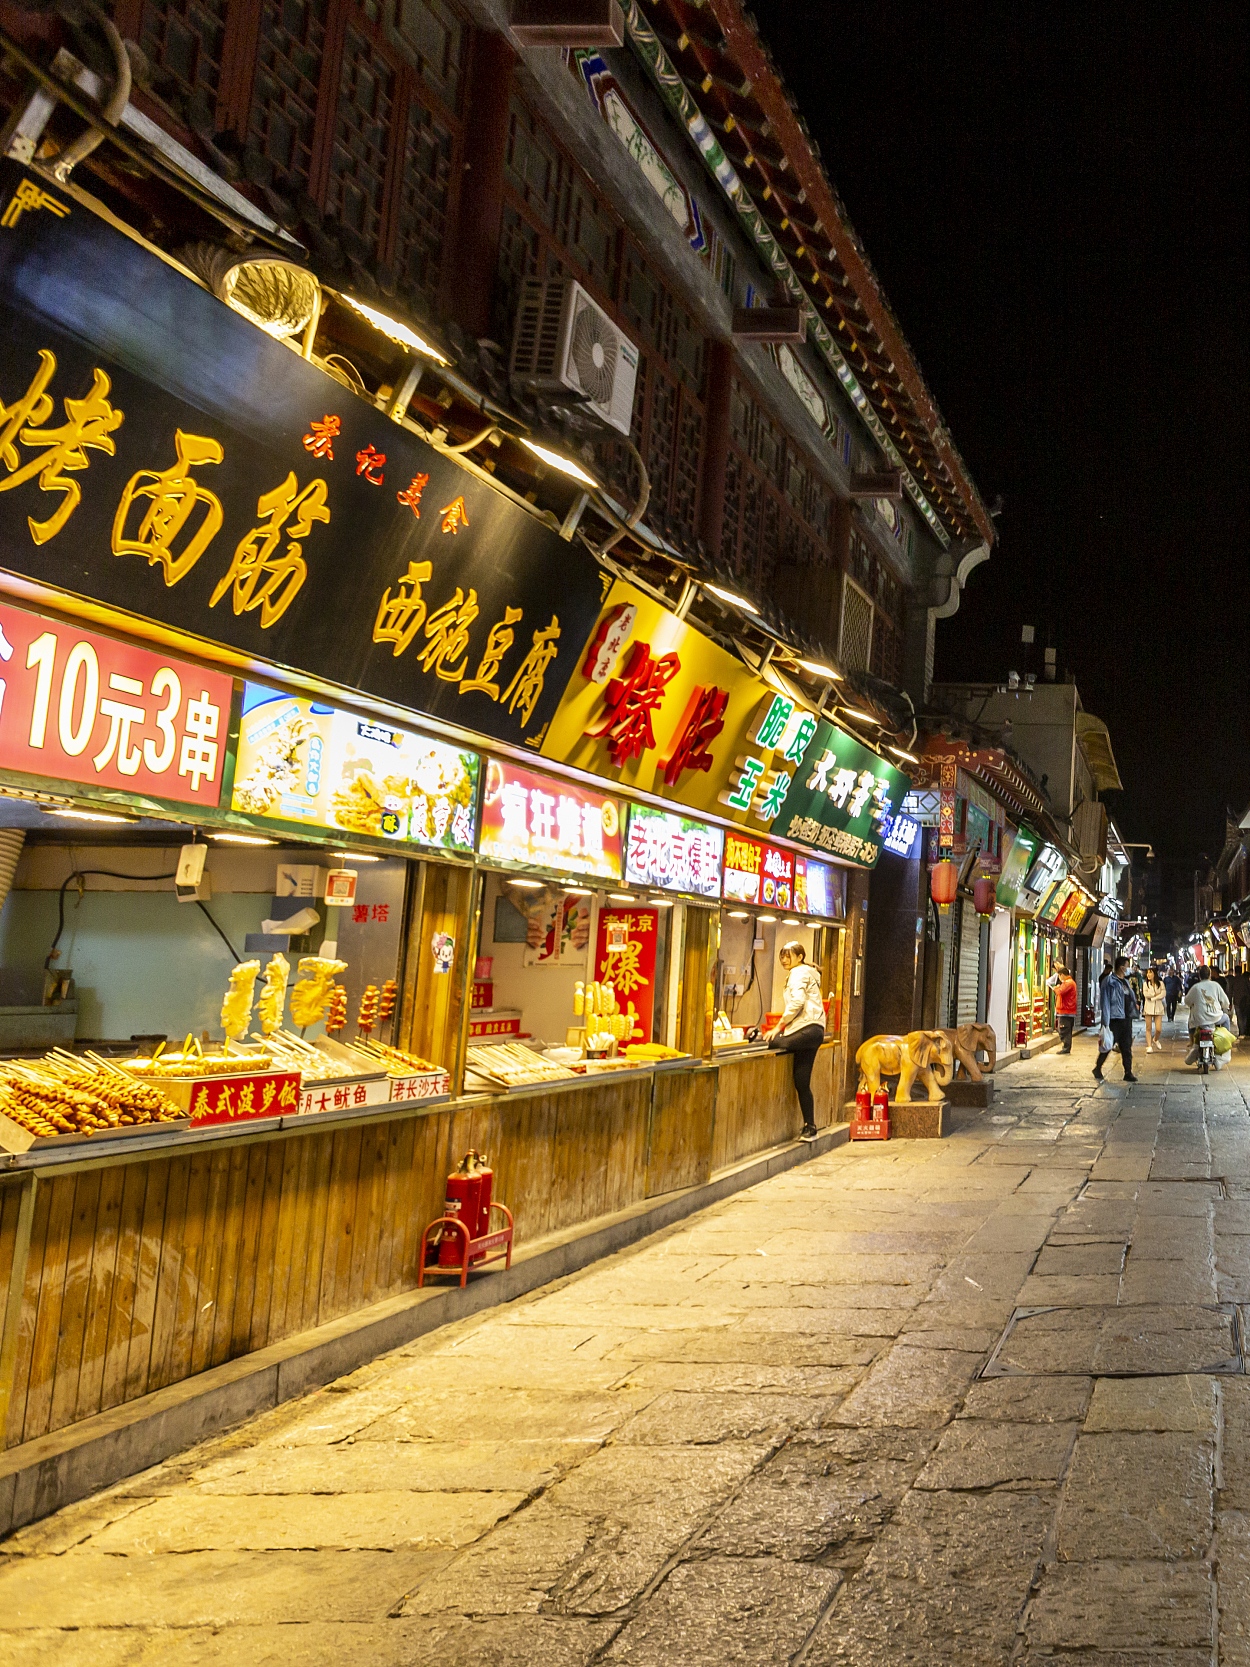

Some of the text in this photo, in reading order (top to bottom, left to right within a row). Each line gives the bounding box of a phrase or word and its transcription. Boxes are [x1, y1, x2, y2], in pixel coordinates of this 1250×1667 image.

[0, 349, 331, 629] 烤面筋
[372, 559, 562, 729] 西施豆腐
[600, 613, 632, 679] 老北京
[0, 620, 220, 792] 10元3串
[756, 693, 818, 766] 脆皮
[729, 756, 791, 822] 玉米
[352, 903, 390, 923] 薯塔
[193, 1079, 298, 1119] 泰式菠萝饭
